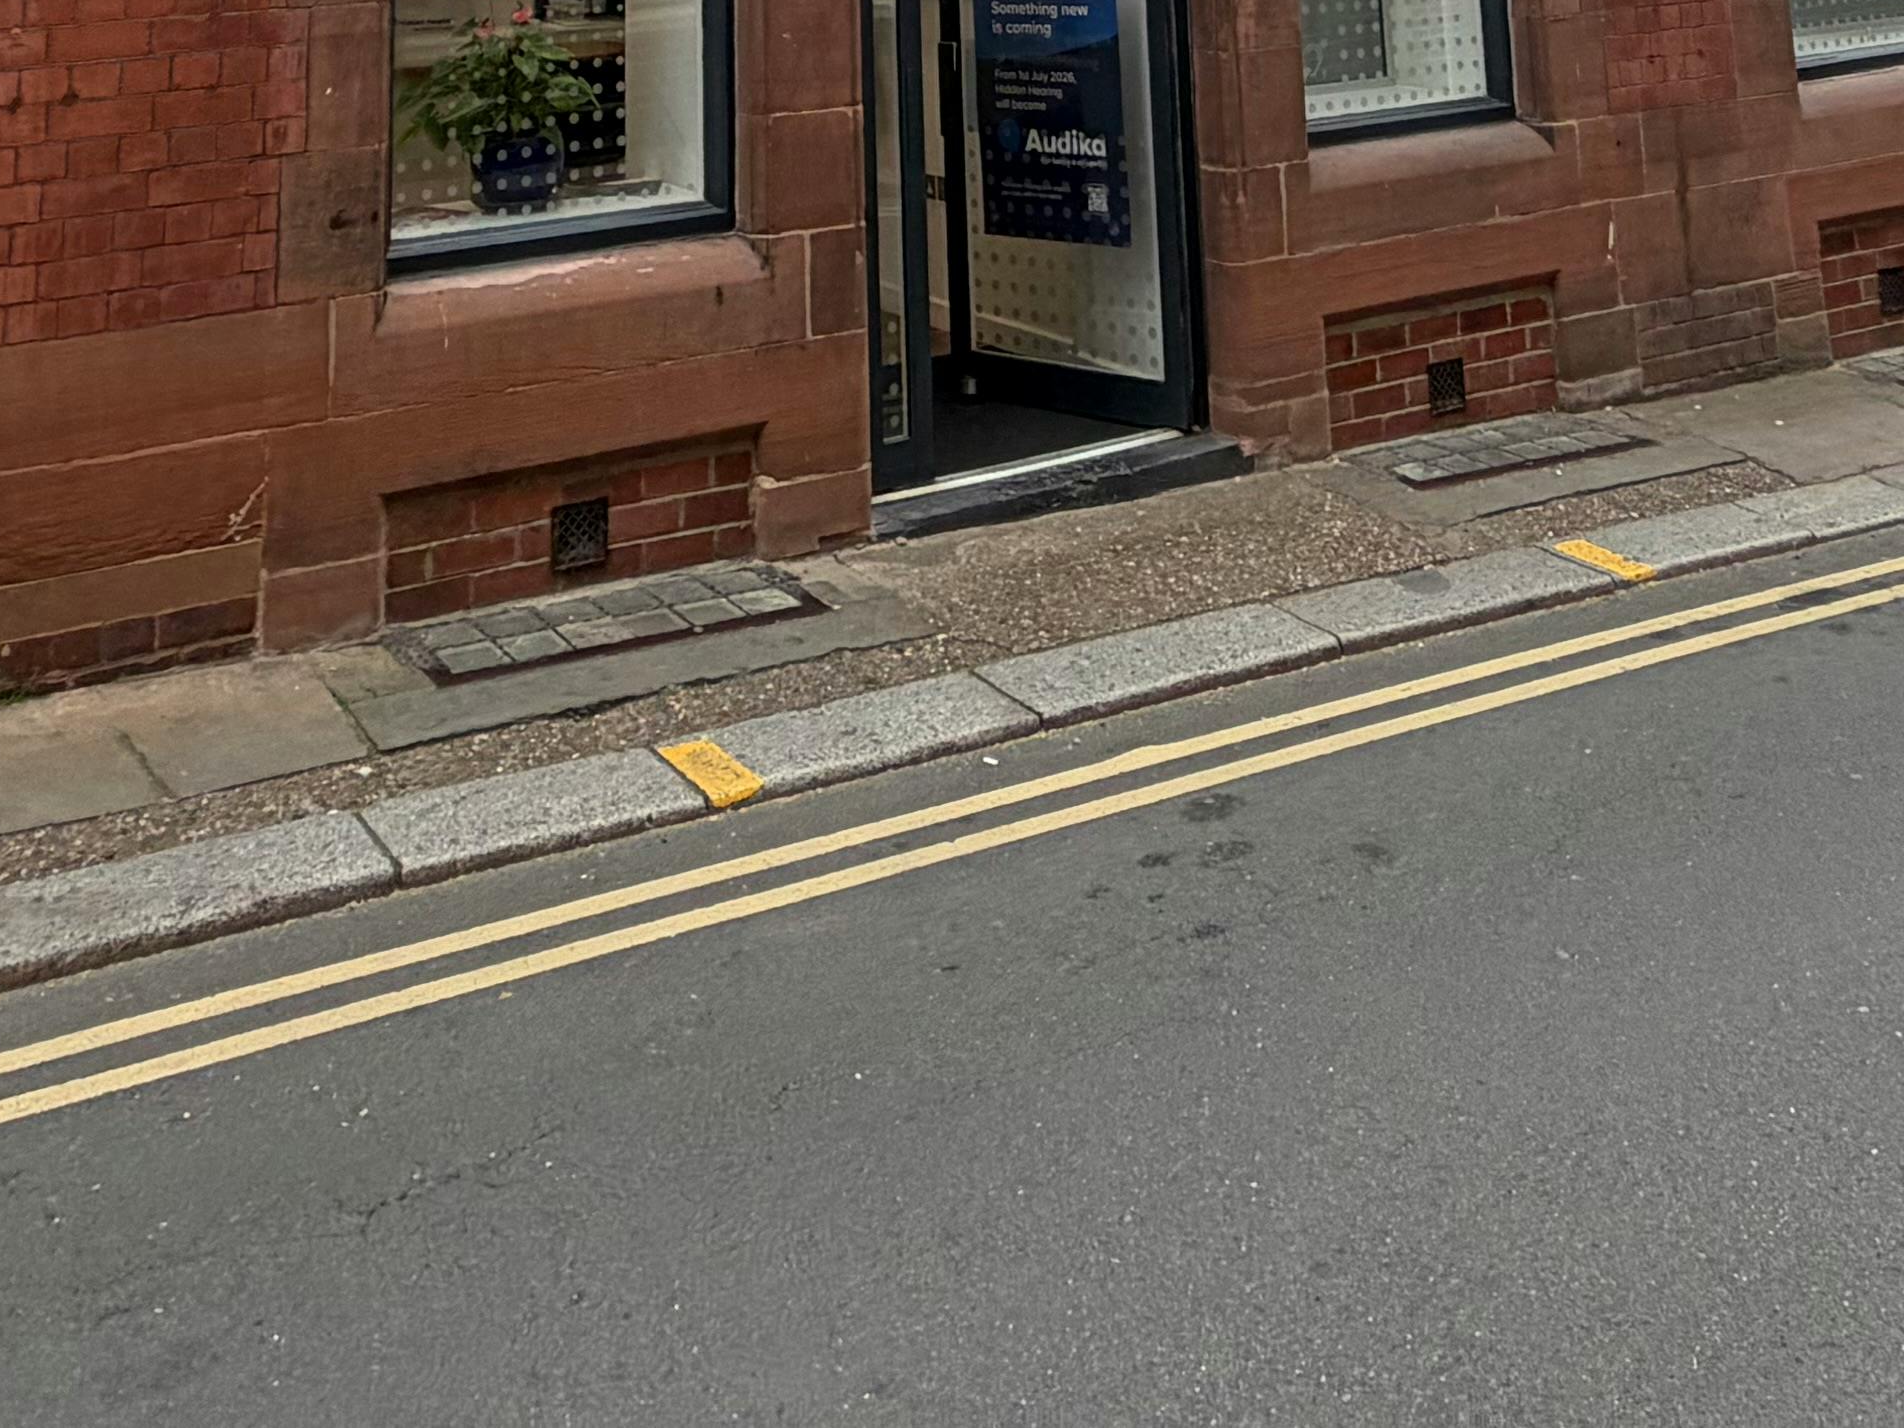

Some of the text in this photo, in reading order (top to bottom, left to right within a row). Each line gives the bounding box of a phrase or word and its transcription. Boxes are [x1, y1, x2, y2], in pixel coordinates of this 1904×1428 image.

[990, 0, 1089, 19] Something new
[991, 19, 1052, 39] is coming
[994, 68, 1017, 81] From
[994, 84, 1064, 100] Hidden Hearing
[1011, 99, 1047, 111] become
[1024, 127, 1107, 157] Audika
